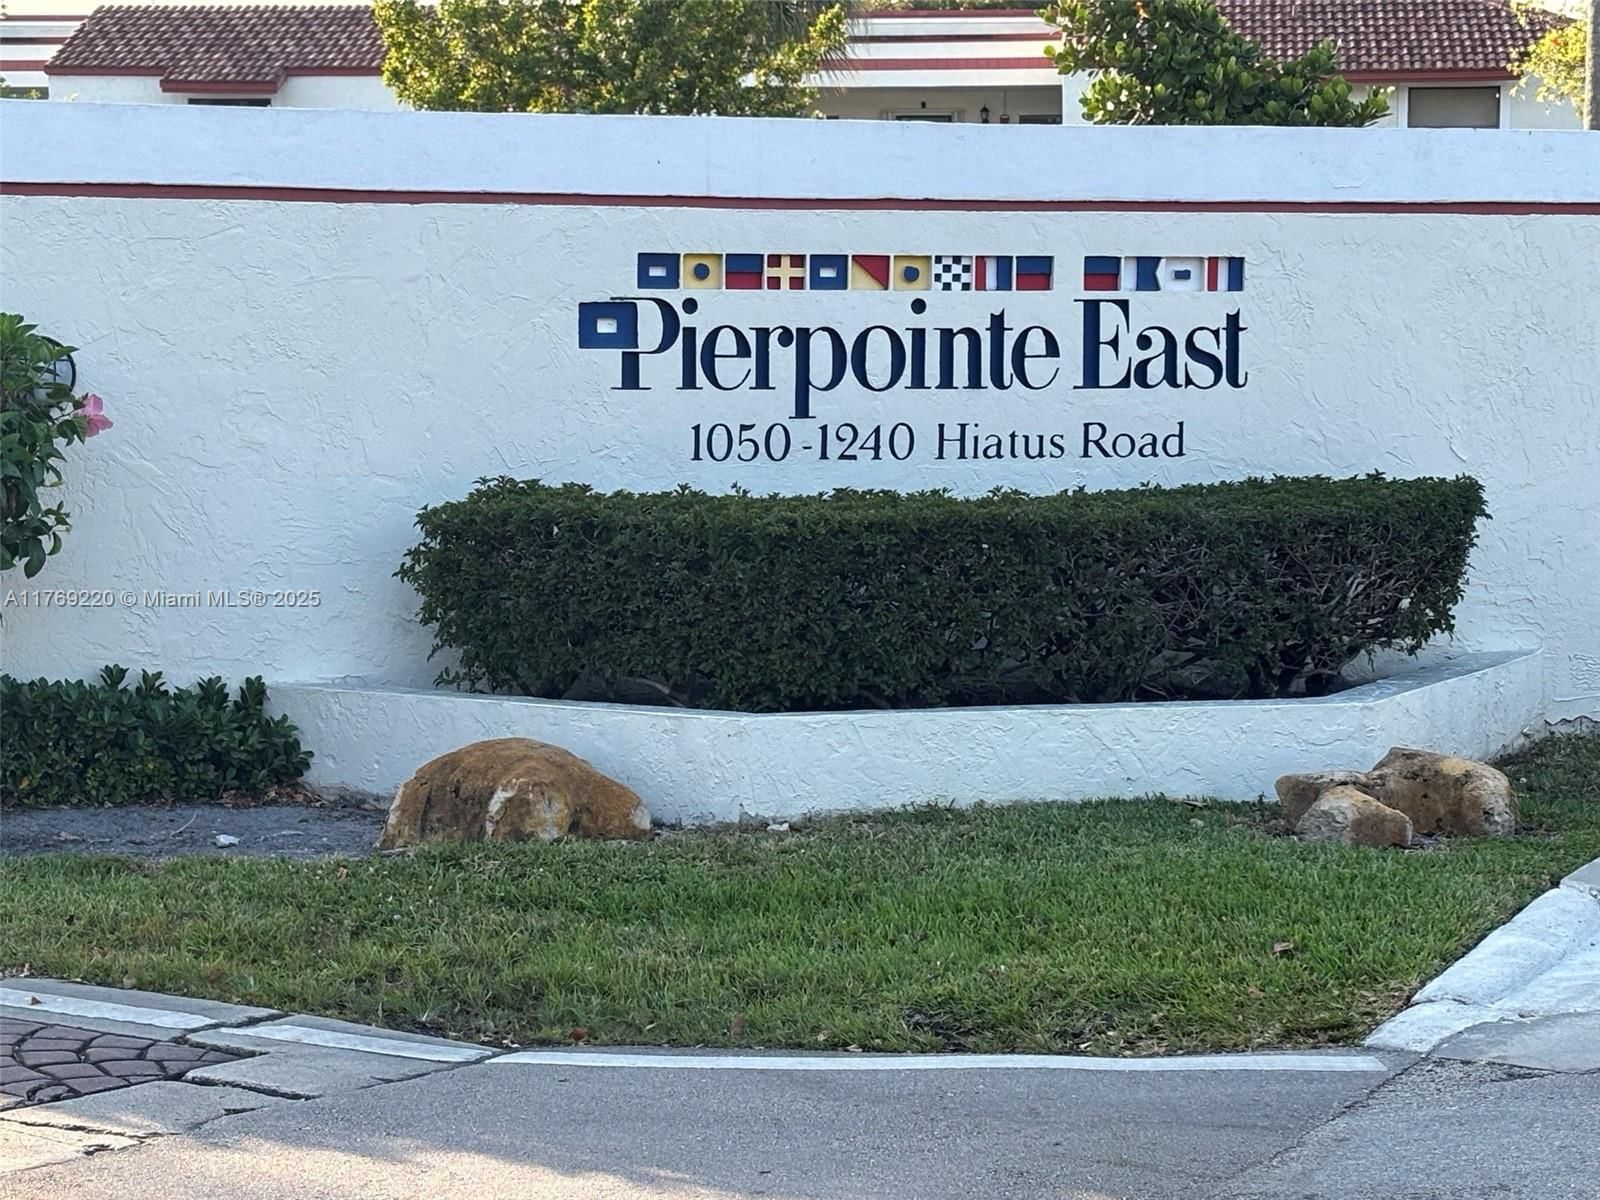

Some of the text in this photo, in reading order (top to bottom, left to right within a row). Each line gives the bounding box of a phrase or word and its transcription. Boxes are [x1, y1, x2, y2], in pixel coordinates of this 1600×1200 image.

[610, 296, 1249, 419] Pierpointe East
[935, 422, 1065, 459] Hiatus
[1080, 421, 1186, 458] Road
